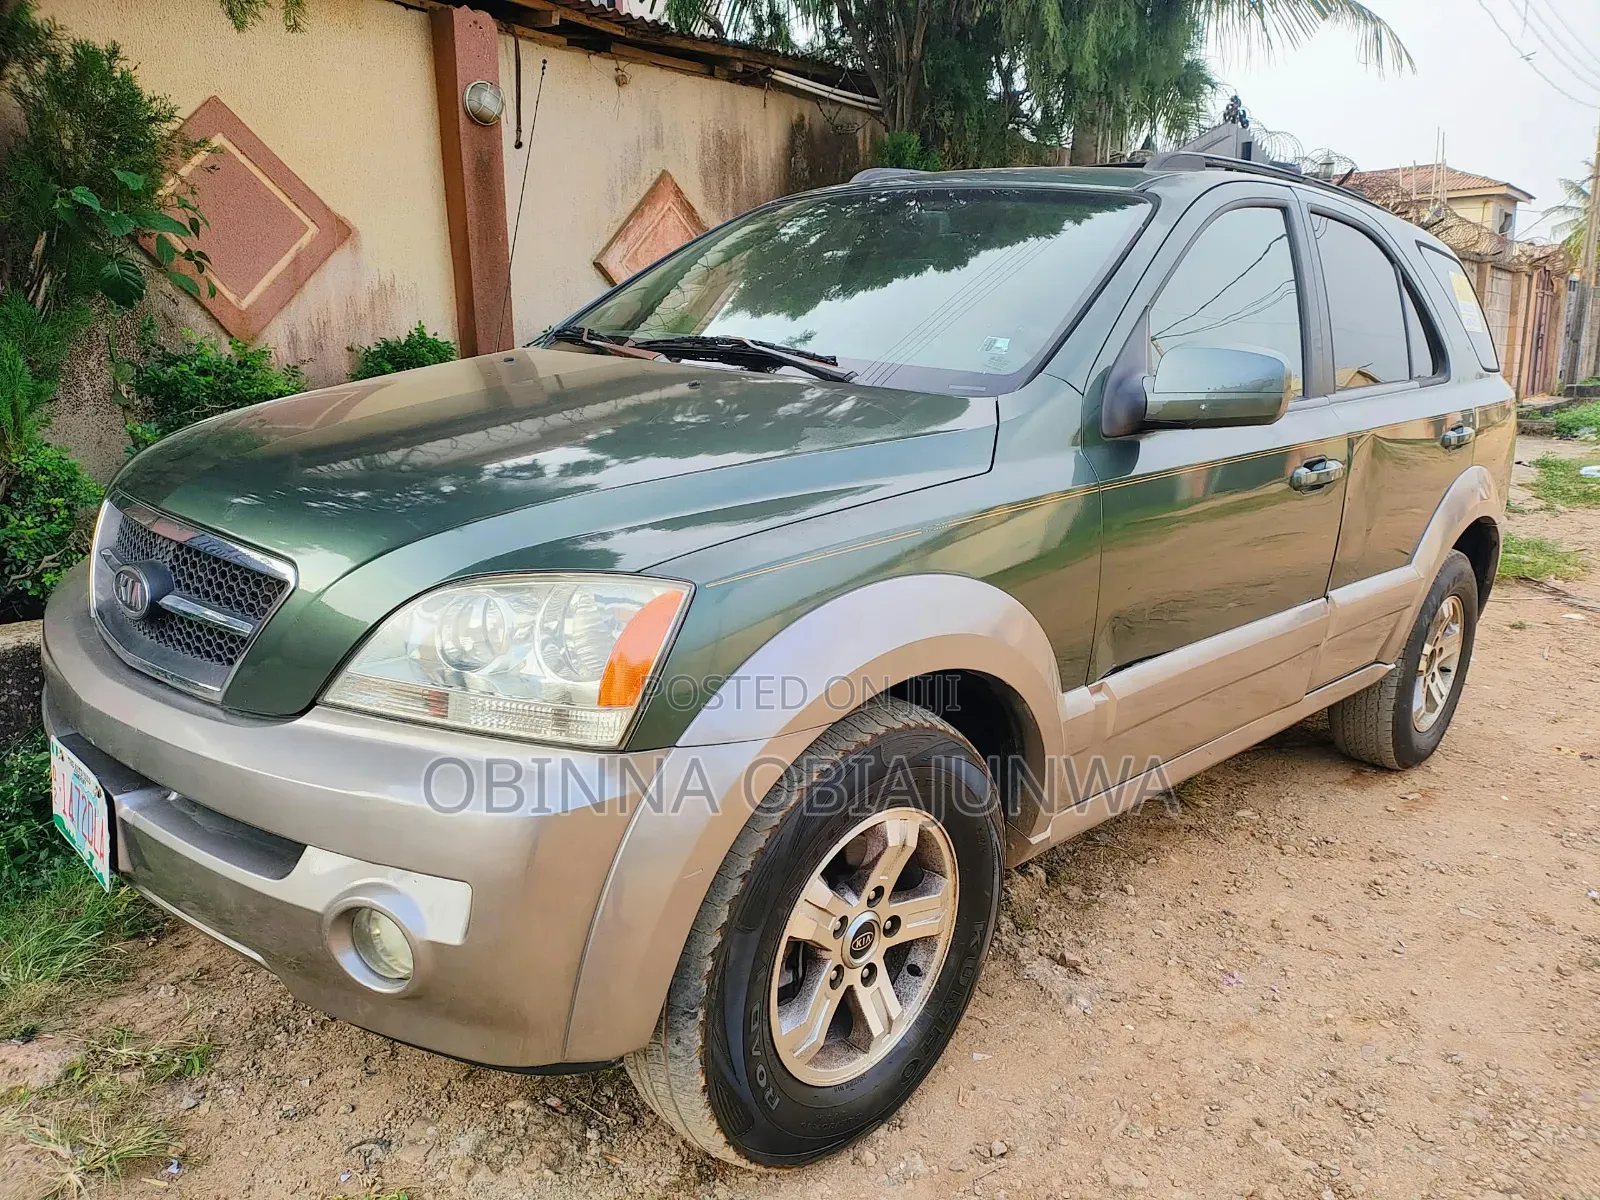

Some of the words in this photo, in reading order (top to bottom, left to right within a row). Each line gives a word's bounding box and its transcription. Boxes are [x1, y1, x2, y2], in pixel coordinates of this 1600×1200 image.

[118, 572, 142, 610] KIA
[751, 1000, 780, 1111] ROAD
[901, 920, 985, 1084] KUMHO
